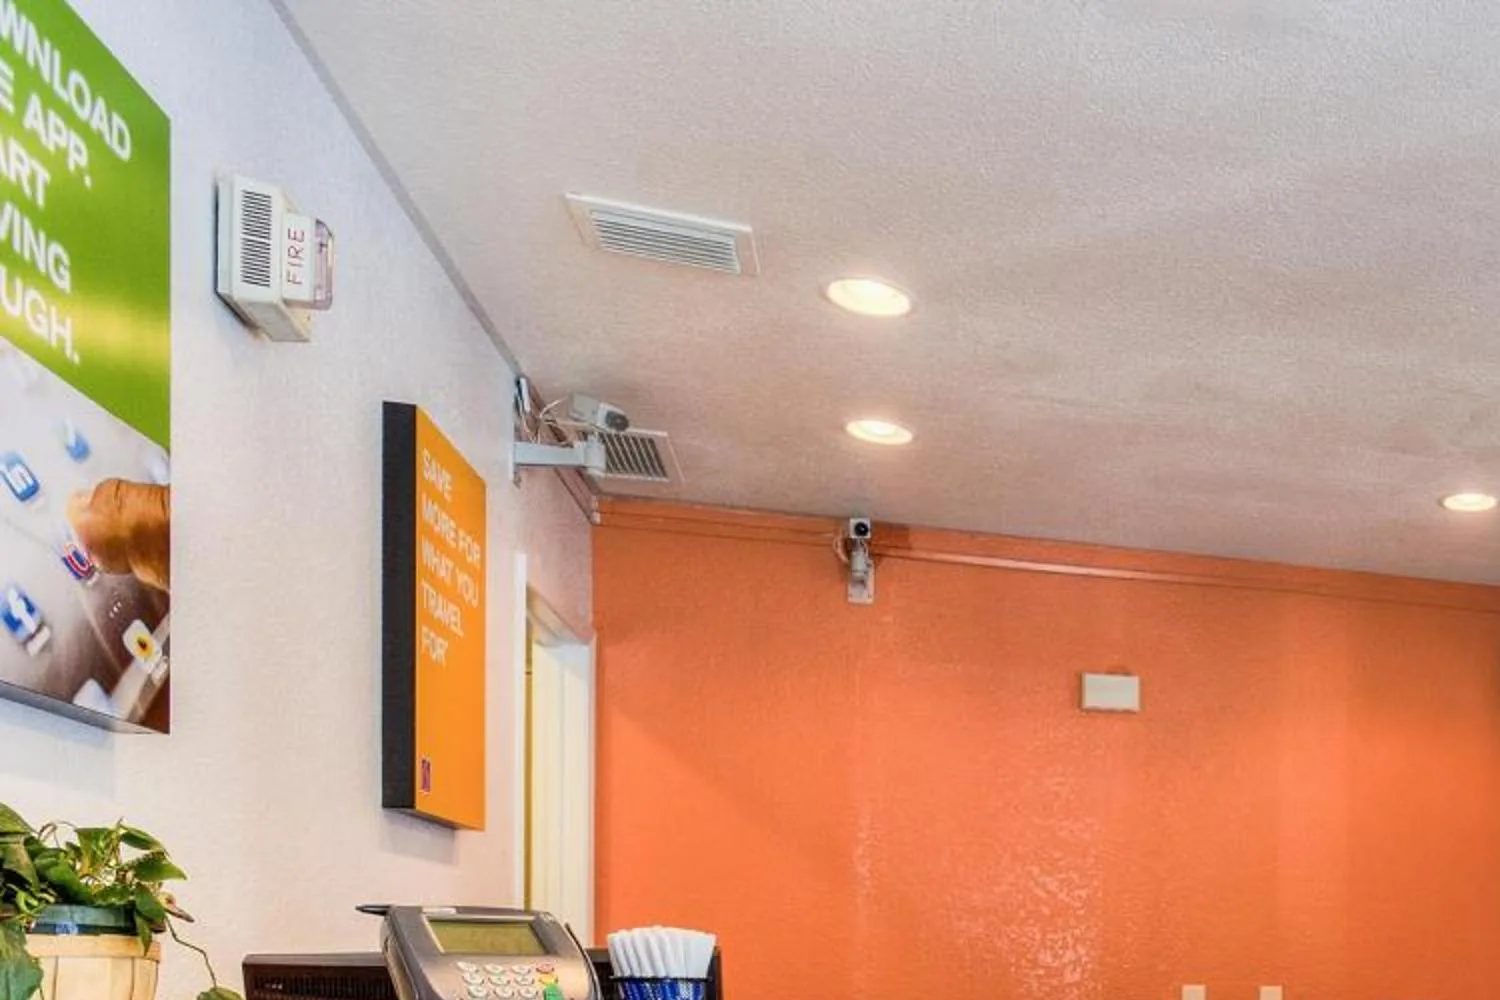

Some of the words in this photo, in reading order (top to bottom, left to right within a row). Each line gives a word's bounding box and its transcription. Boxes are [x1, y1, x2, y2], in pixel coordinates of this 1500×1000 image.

[23, 93, 91, 189] APP.
[287, 228, 305, 285] FIRE
[423, 447, 452, 501] SAVE
[422, 493, 457, 549] MORE
[459, 530, 481, 569] FOR
[422, 540, 455, 586] WHAT
[456, 567, 479, 608] YOU
[421, 578, 464, 637] TRAVEL
[421, 625, 448, 668] FOR
